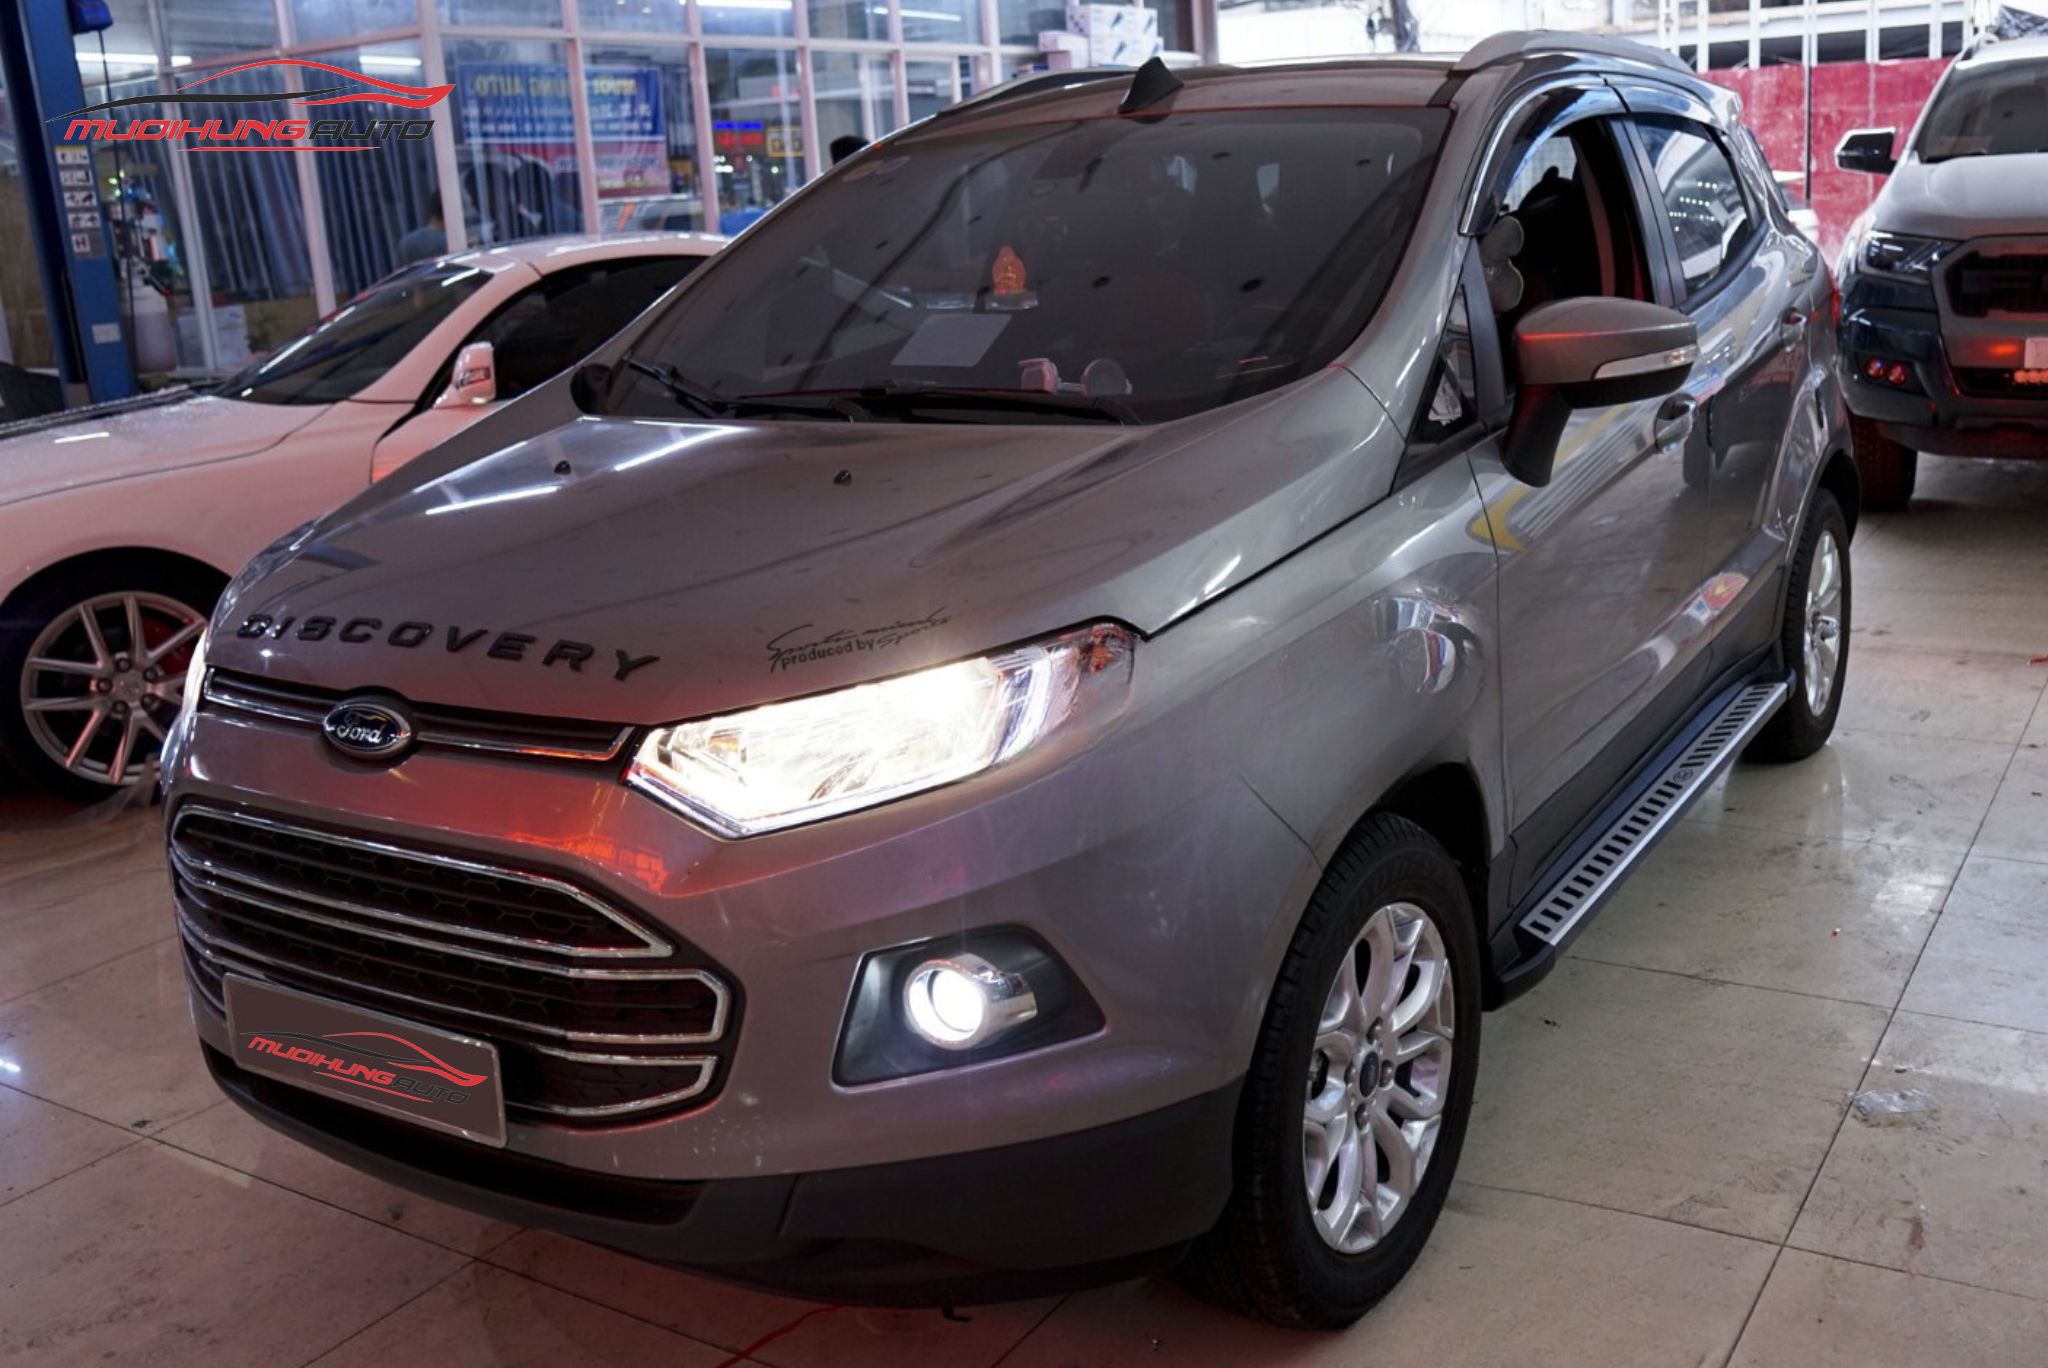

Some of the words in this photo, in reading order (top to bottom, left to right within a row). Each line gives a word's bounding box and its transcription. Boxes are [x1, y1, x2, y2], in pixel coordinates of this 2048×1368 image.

[237, 613, 661, 682] DISCOVERY
[780, 639, 853, 671] produced
[856, 635, 876, 650] by
[336, 711, 388, 744] Ford
